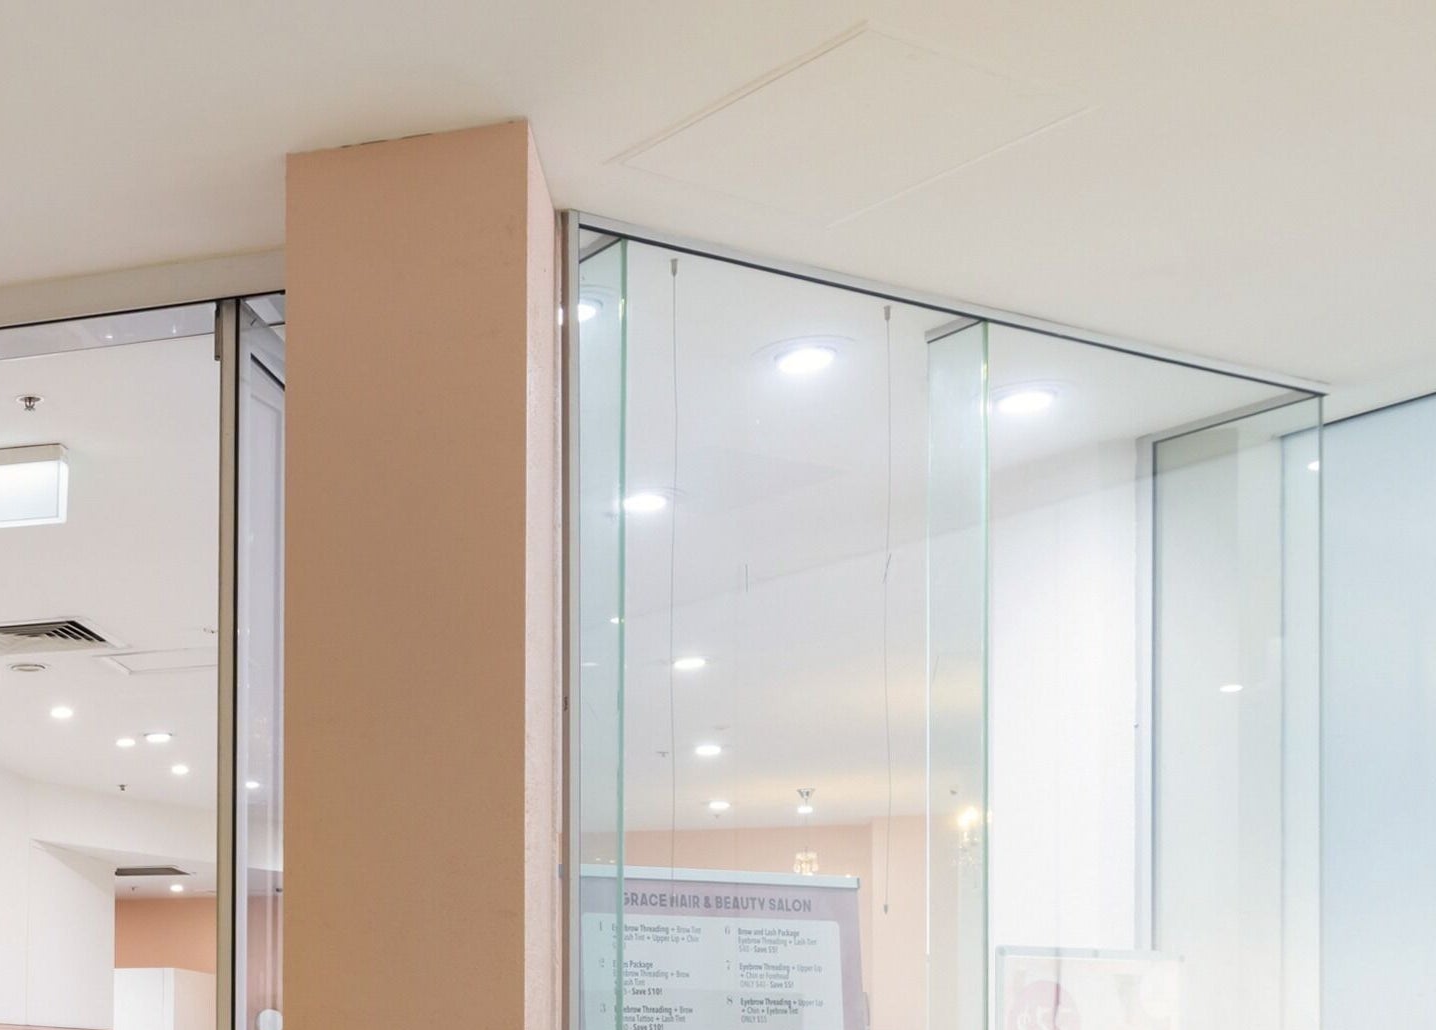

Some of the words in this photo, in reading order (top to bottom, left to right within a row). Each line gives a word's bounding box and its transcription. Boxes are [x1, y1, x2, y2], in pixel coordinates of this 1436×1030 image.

[669, 894, 700, 909] HAIR
[703, 895, 711, 909] &
[715, 896, 765, 910] BEAUTY
[769, 898, 812, 912] SALON
[640, 924, 669, 934] Threading
[629, 960, 653, 969] Package
[631, 987, 646, 995] Save
[643, 1005, 672, 1015] Threading
